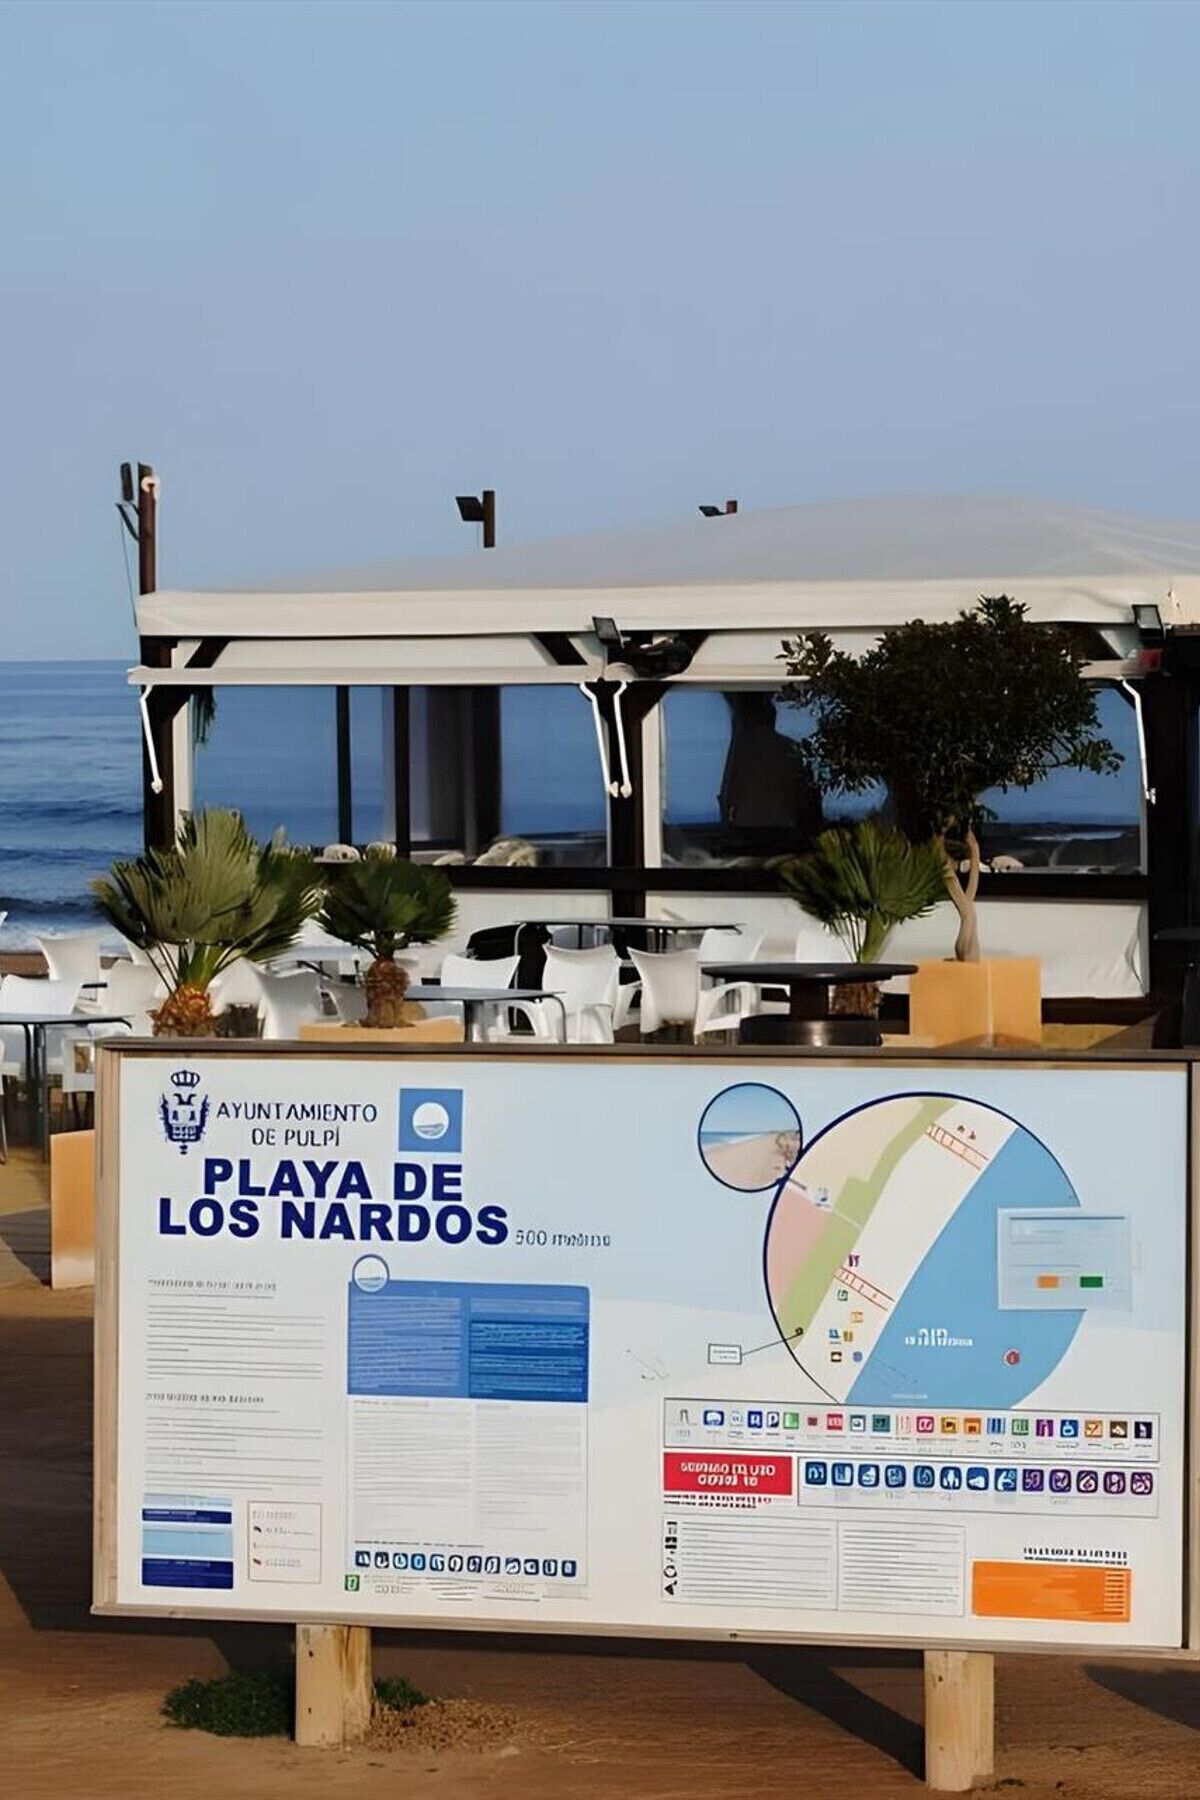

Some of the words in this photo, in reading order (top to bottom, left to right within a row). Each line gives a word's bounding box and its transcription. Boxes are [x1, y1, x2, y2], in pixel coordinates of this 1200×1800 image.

[216, 1101, 378, 1123] AYUNTAMIENTO
[251, 1127, 276, 1146] DE
[284, 1126, 340, 1147] PULPÍ
[203, 1157, 373, 1200] PLAYA
[394, 1162, 463, 1202] DE
[159, 1197, 260, 1239] LOS
[281, 1200, 509, 1246] NARDOS
